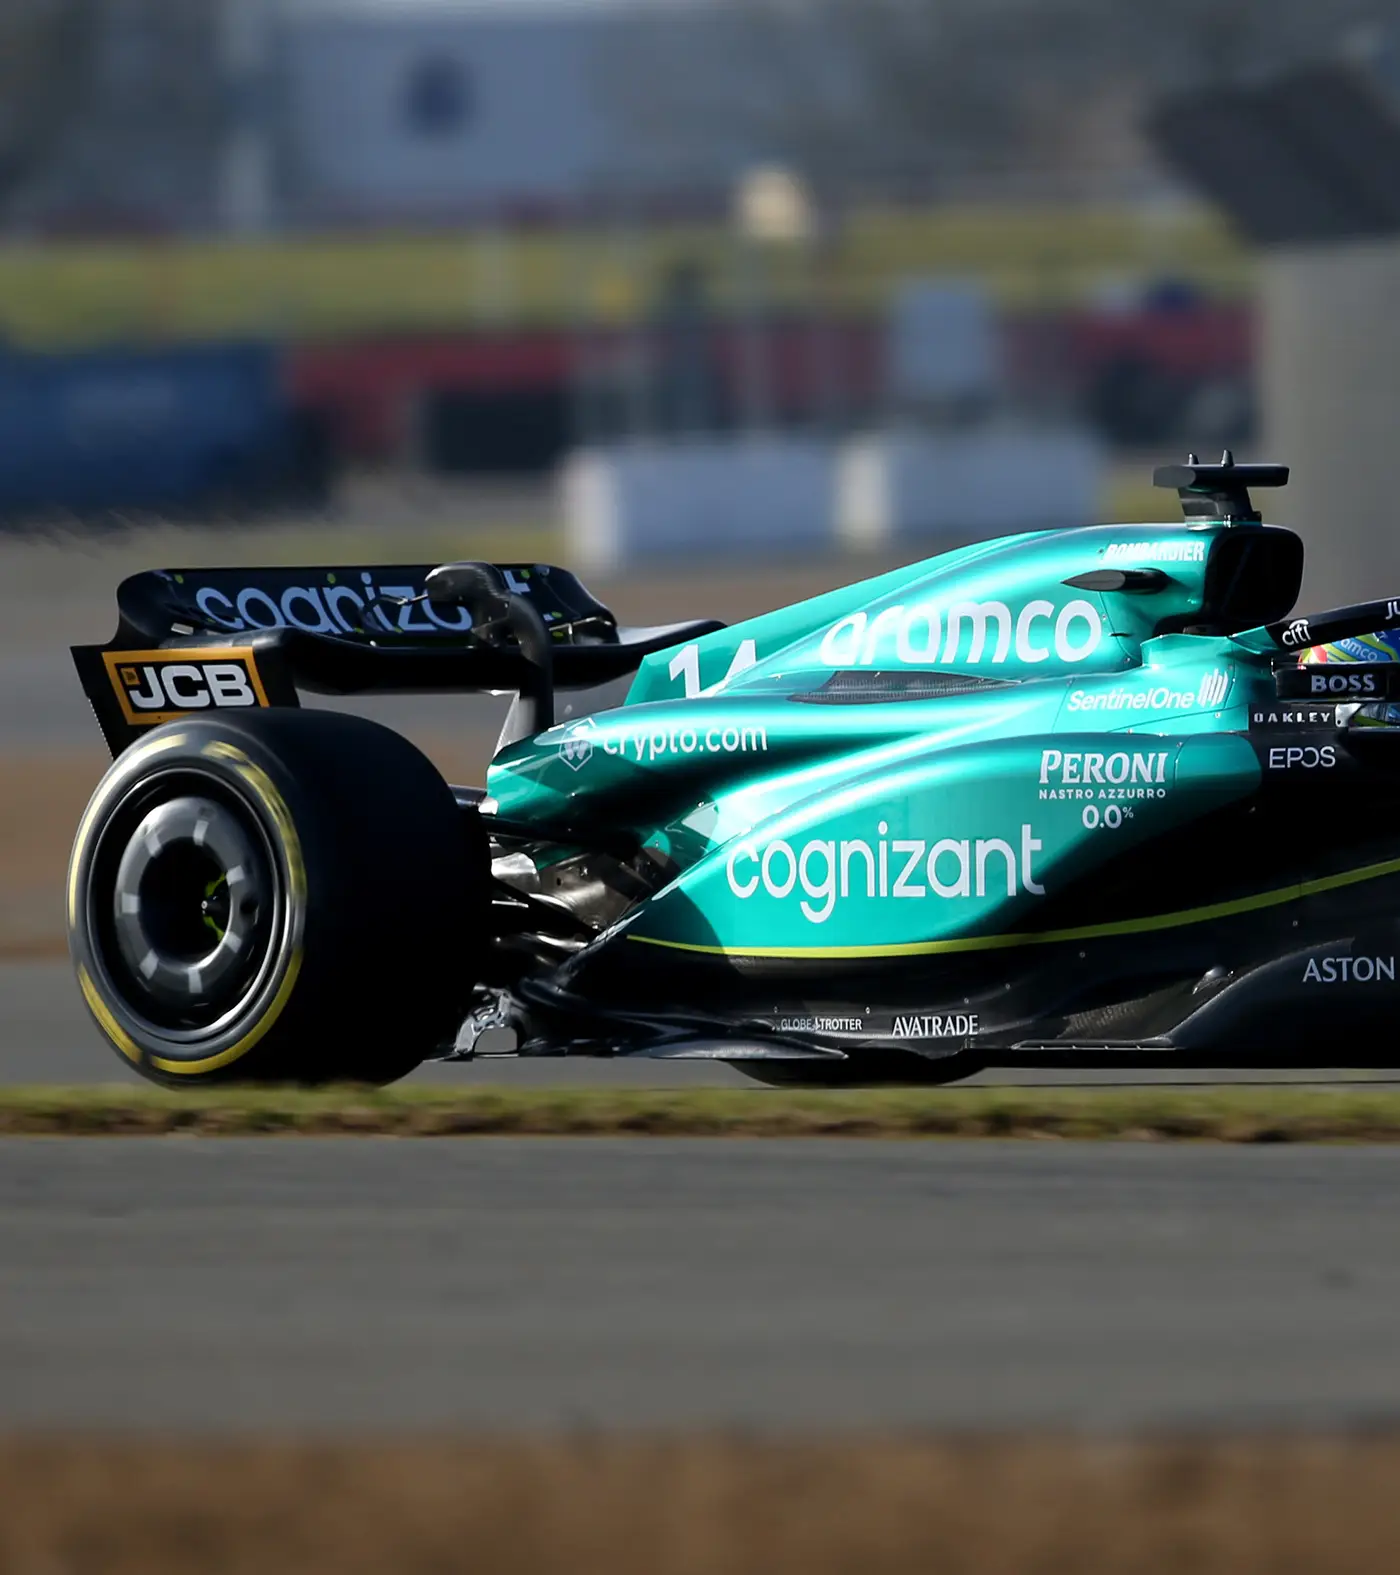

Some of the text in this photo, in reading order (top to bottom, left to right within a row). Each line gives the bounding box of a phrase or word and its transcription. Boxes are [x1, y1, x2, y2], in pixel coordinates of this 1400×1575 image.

[820, 600, 1102, 666] aramco
[1282, 619, 1311, 646] citi
[129, 664, 255, 709] JCB
[1311, 674, 1375, 692] BOSS
[1067, 687, 1195, 711] SentinelOne
[1254, 712, 1330, 723] OAKLEY
[603, 726, 768, 761] crypto.com
[1039, 750, 1168, 784] PERONI
[1039, 788, 1166, 800] NASTRO AZZURRO
[1082, 804, 1134, 829] 0.0%
[726, 821, 1046, 924] cognizant
[1302, 957, 1395, 982] ASTON
[780, 1018, 862, 1031] GLOBE TROTTER
[892, 1015, 978, 1036] AVATRADE
